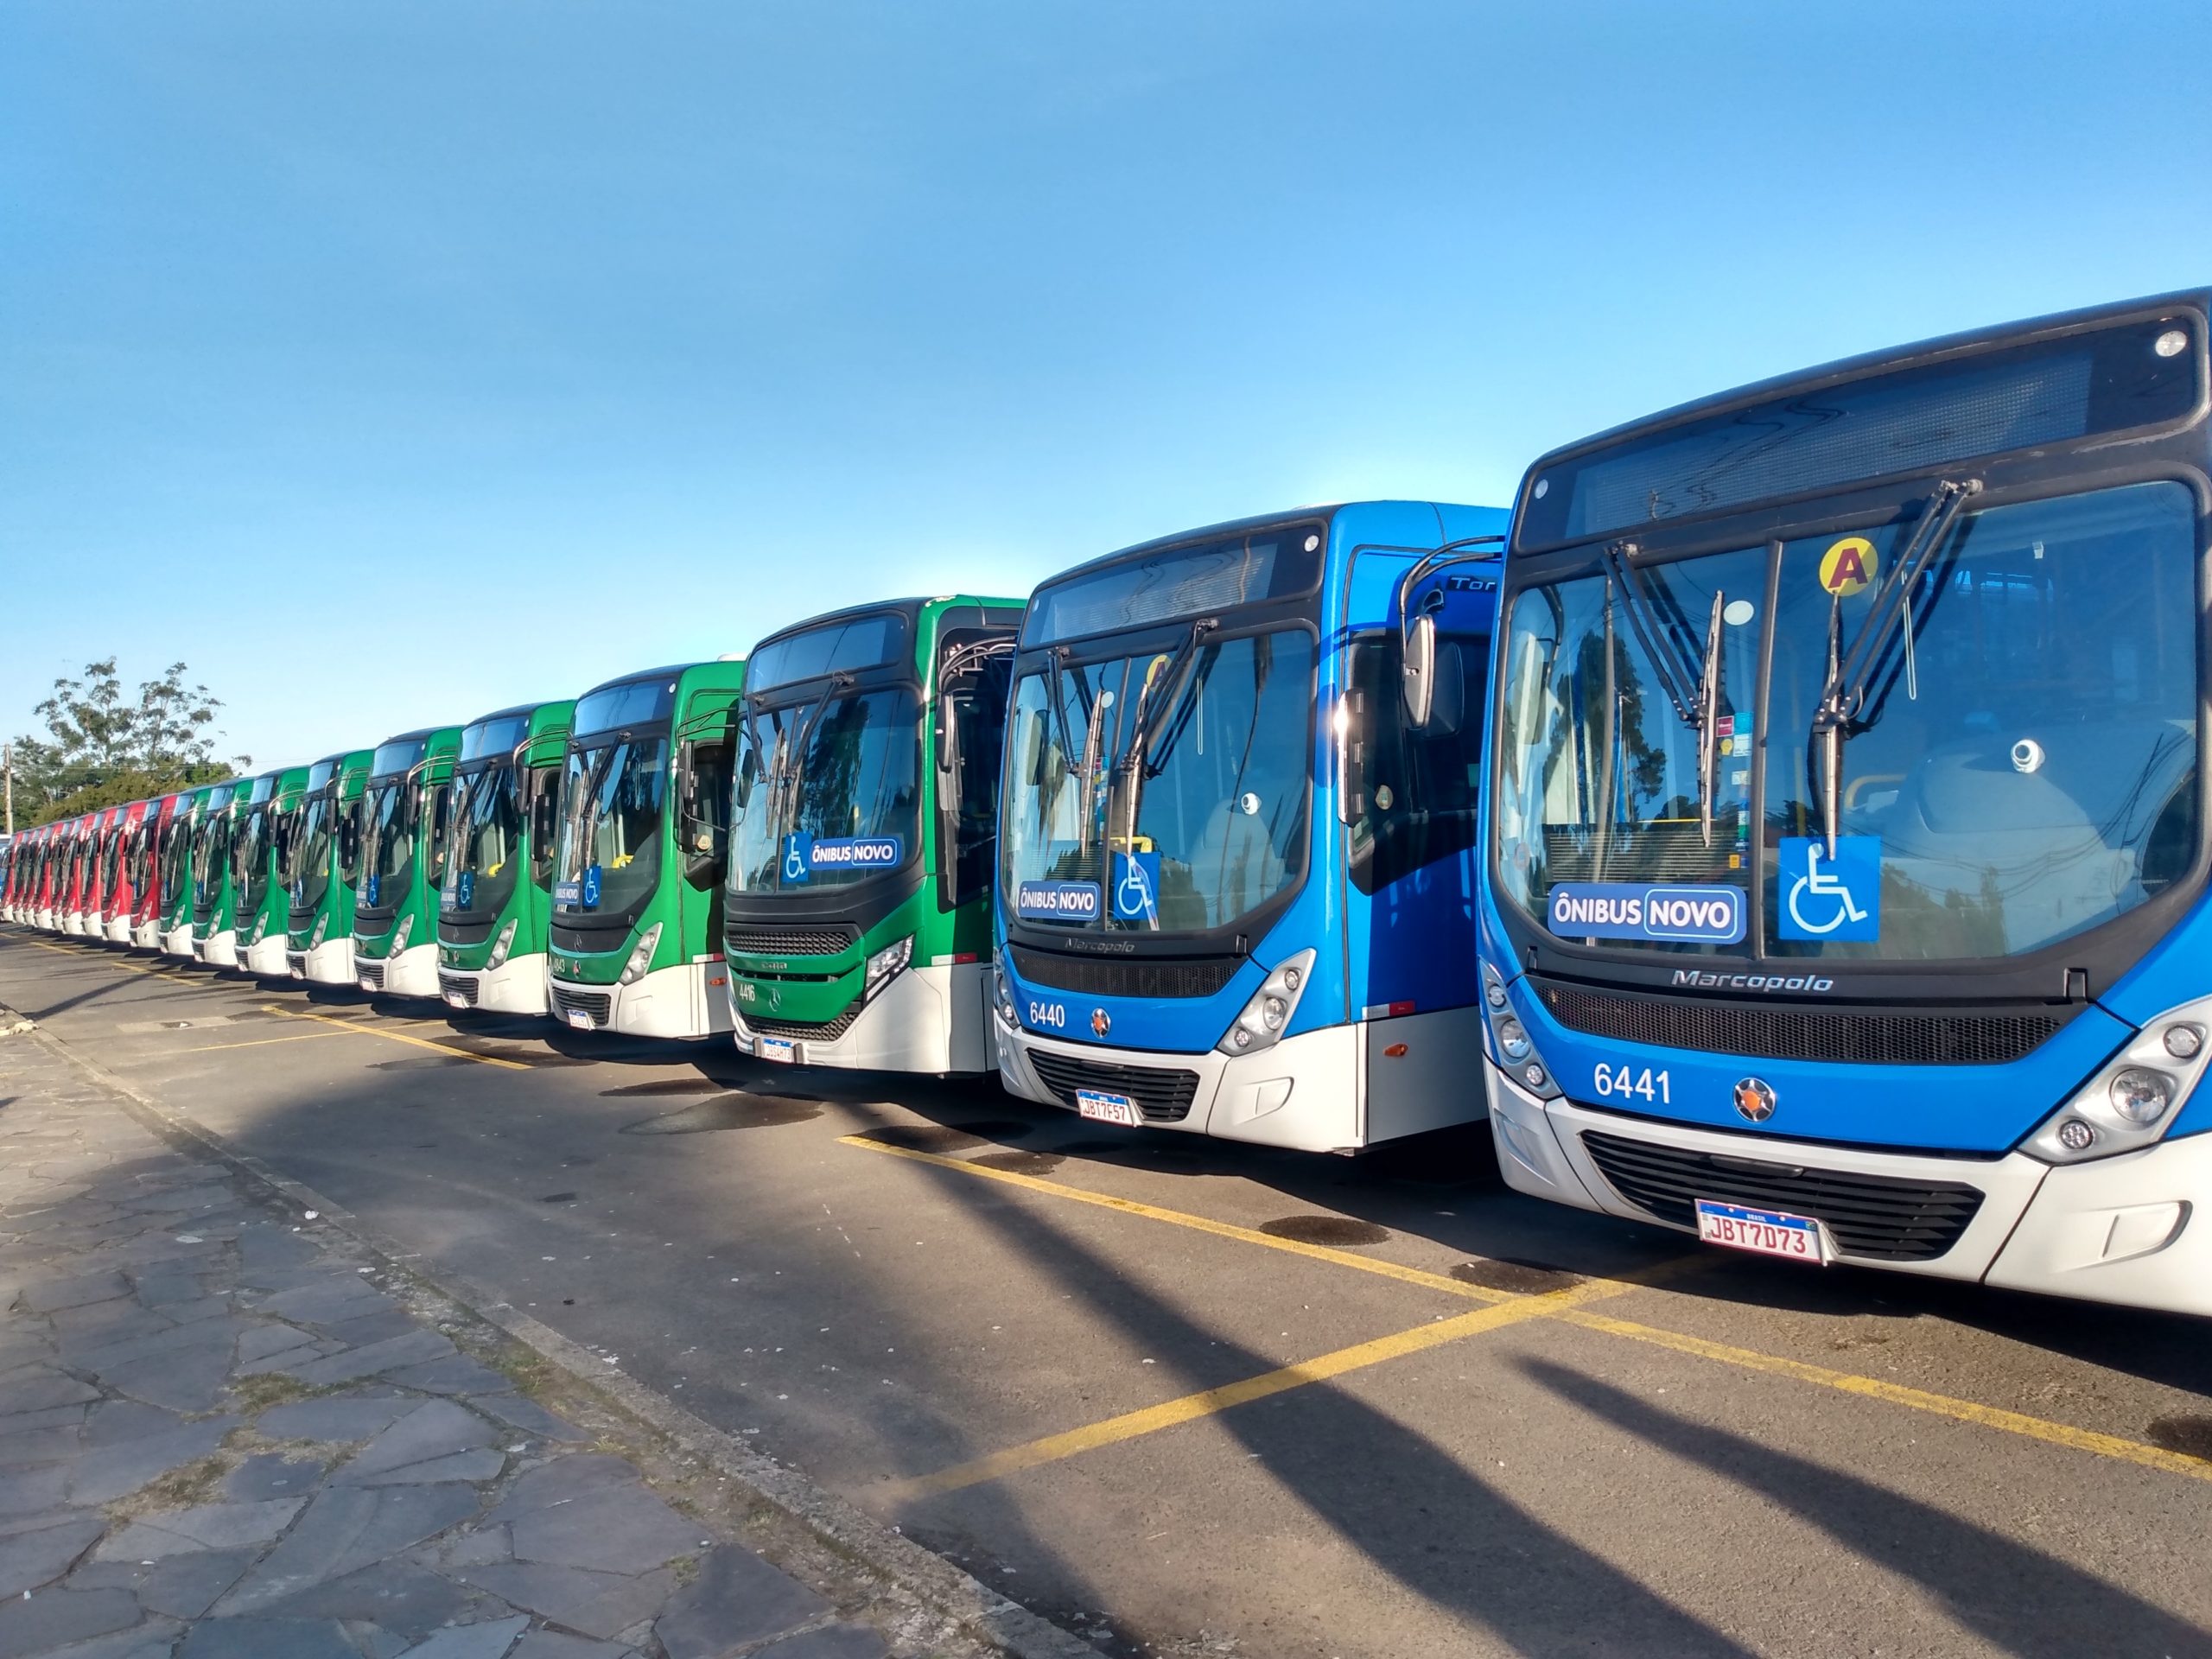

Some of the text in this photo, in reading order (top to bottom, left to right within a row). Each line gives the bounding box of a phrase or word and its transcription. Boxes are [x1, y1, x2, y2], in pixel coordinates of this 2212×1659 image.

[1827, 547, 1868, 588] A
[1451, 577, 1496, 590] Tor
[812, 844, 893, 863] ÔNIBUS NOVO
[1020, 887, 1094, 911] ÔNIBUS NOVO
[1554, 892, 1730, 929] ÔNIBUS NOVO
[1065, 938, 1135, 953] Marcopolo
[1671, 969, 1834, 992] Marcopolo
[739, 984, 755, 1001] 4416
[1030, 1001, 1065, 1028] 6440
[1594, 1063, 1670, 1104] 6441
[1084, 1099, 1125, 1121] JBT7F57
[1710, 1217, 1807, 1254] JBT7D73
